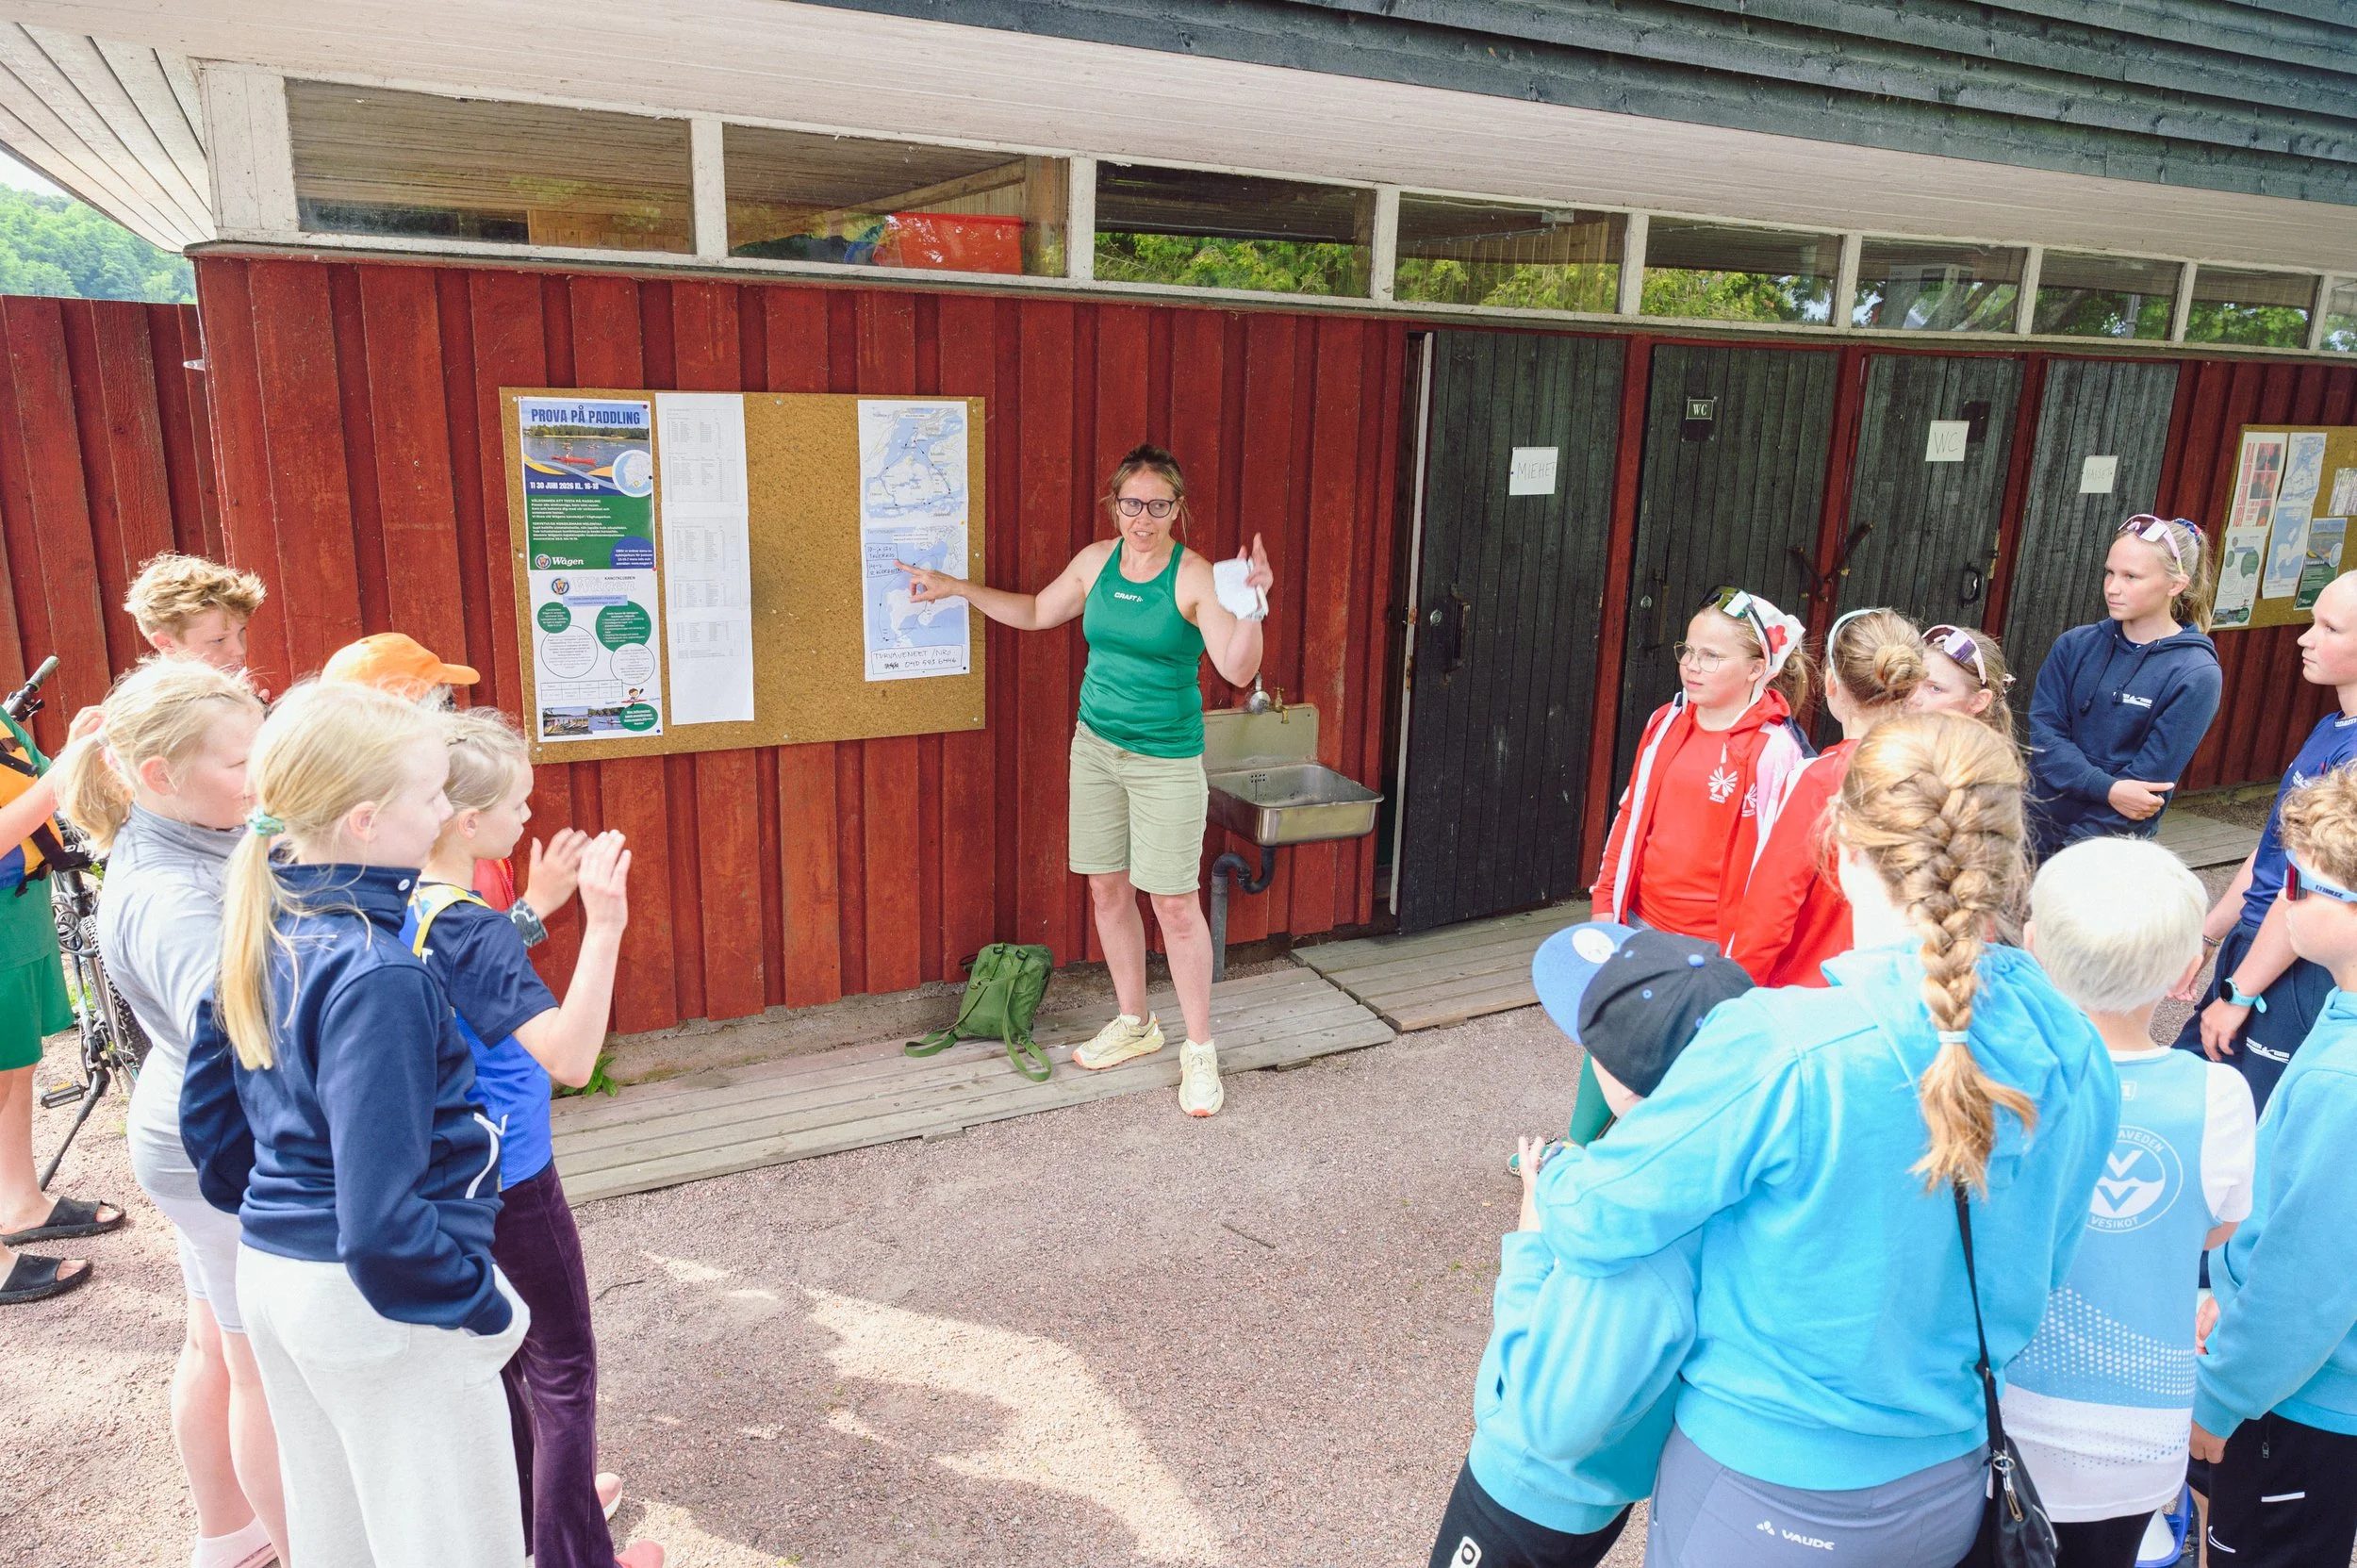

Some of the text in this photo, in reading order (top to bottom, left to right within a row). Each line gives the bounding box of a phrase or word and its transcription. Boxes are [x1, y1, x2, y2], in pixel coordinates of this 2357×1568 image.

[531, 404, 640, 424] PROVA PÅ PADDLING
[1693, 404, 1707, 416] WC
[1934, 431, 1958, 454] WC
[552, 556, 585, 568] Wågen
[1113, 592, 1138, 601] CRAFT
[2118, 1129, 2165, 1153] AVEDEN
[2091, 1215, 2139, 1229] VESIKOT
[1782, 1528, 1835, 1551] VAUDE
